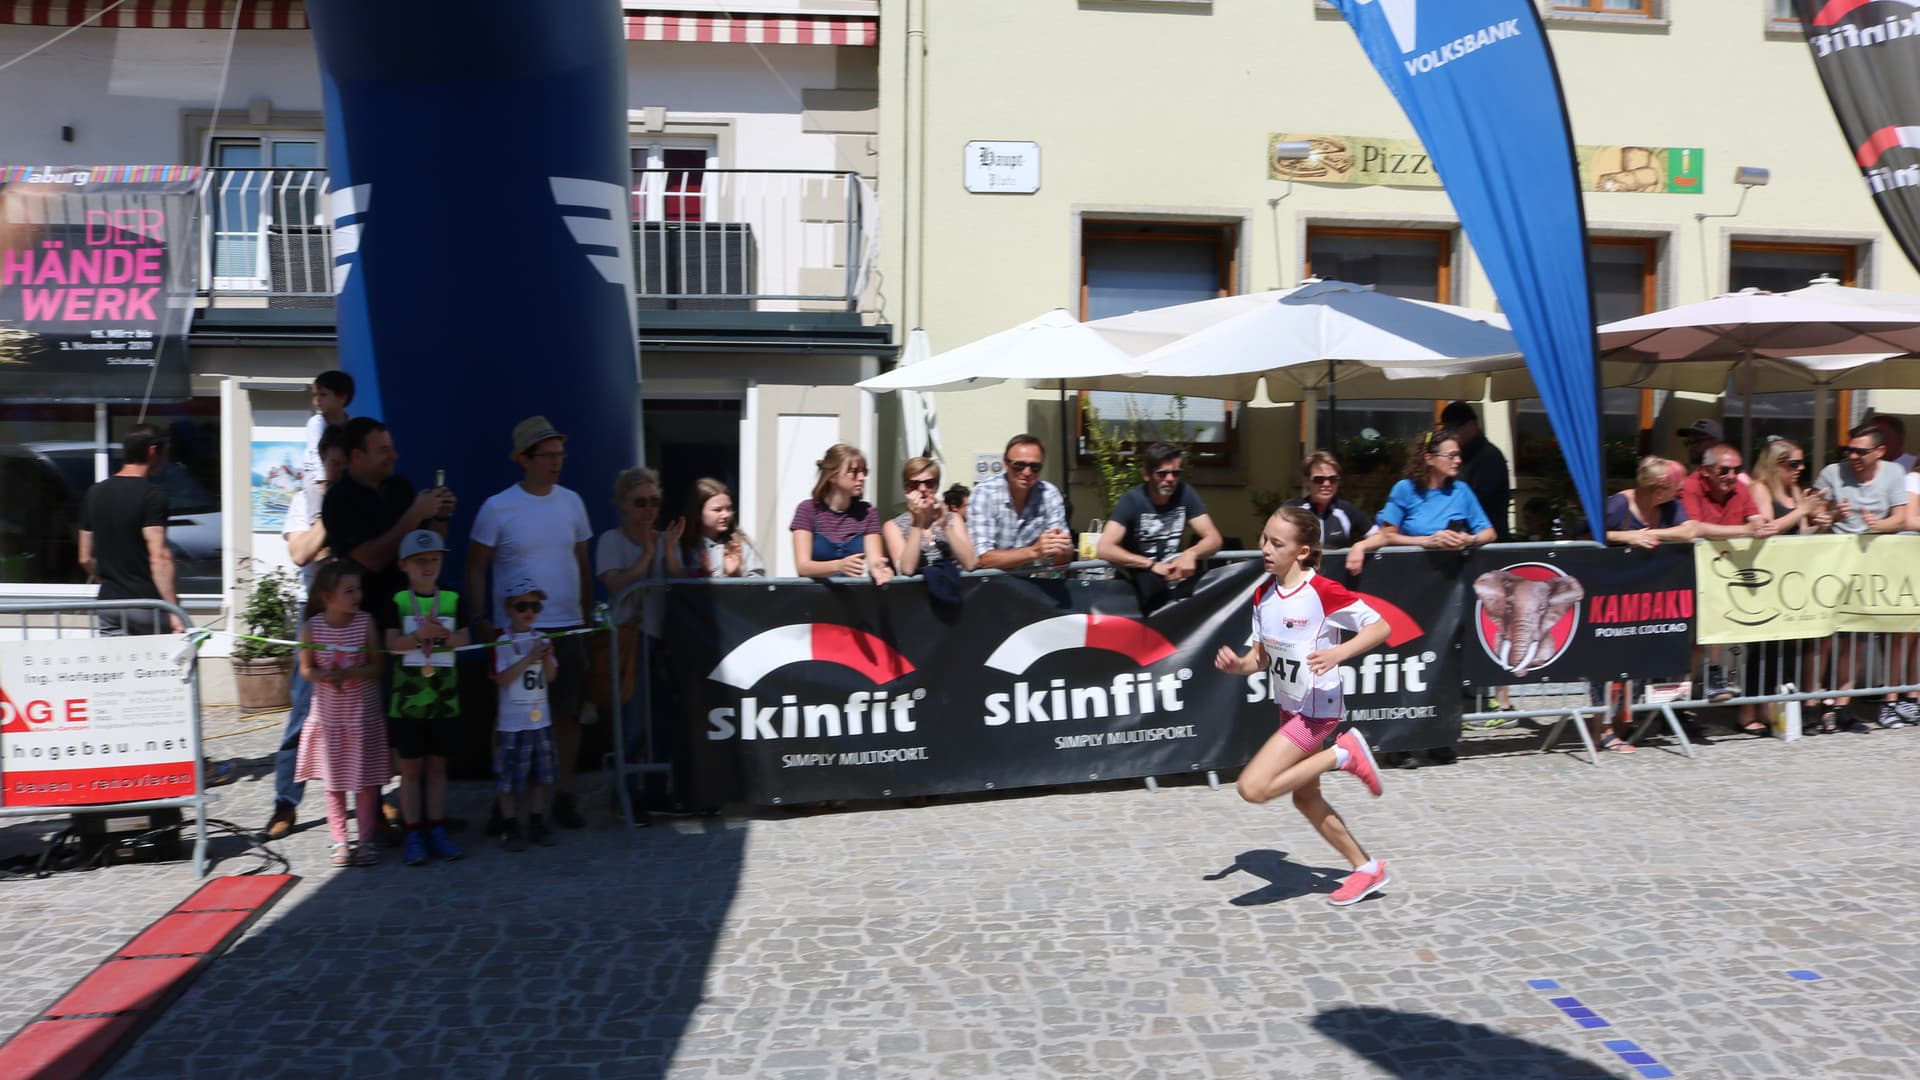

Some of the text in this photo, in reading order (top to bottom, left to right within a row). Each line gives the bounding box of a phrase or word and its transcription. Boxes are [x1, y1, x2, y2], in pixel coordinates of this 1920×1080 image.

[1404, 19, 1521, 76] VOLKSBANK
[1360, 145, 1438, 174] Pizz
[86, 209, 165, 246] DER
[2, 240, 163, 285] HÄNDE
[21, 288, 161, 321] WERK
[1778, 571, 1920, 610] CORRA
[1588, 589, 1694, 624] KAMBAKU
[1595, 627, 1637, 638] POWER
[23, 650, 170, 667] Baumeiste
[1269, 656, 1301, 683] 47
[1054, 733, 1104, 750] SIMPLY
[782, 753, 836, 768] SIMPLY
